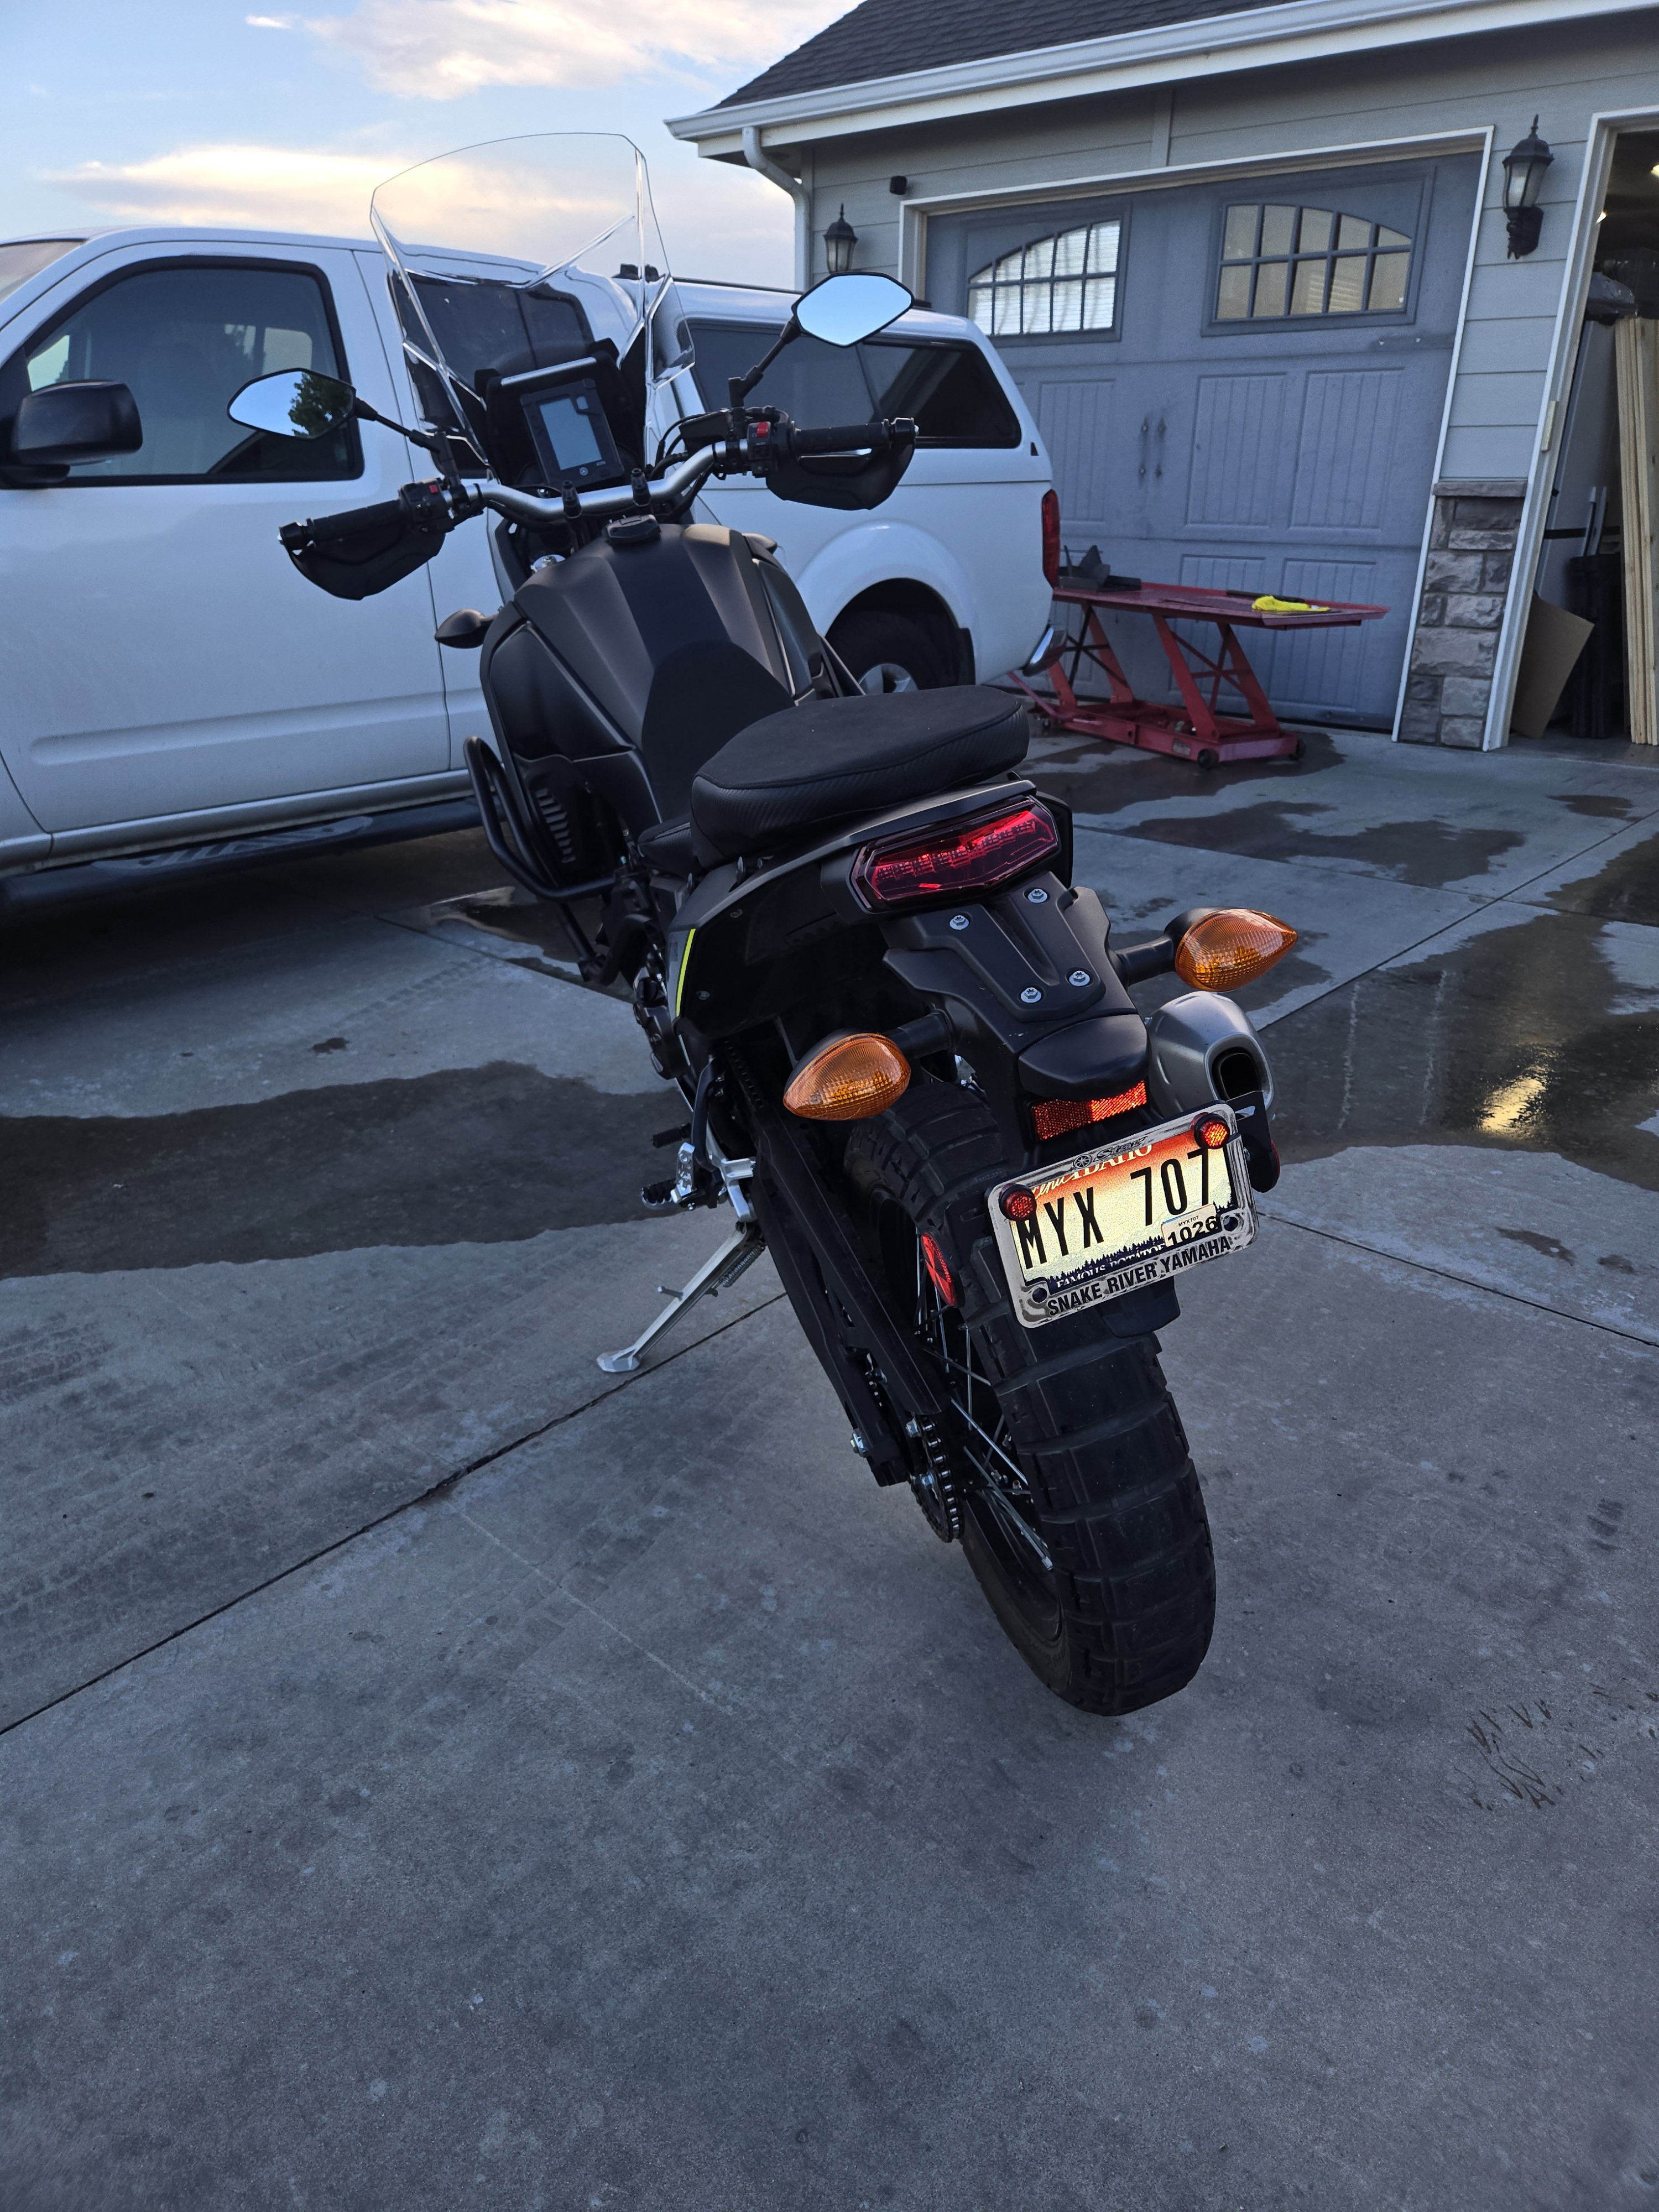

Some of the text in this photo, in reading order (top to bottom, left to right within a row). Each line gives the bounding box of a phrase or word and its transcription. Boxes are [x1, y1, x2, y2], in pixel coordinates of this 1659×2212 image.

[1016, 1147, 1209, 1270] MYX 707
[1168, 1216, 1217, 1245] 1026
[1178, 1215, 1199, 1227] MYX707
[1047, 1236, 1231, 1316] SNAKE RIVER YAMAHA
